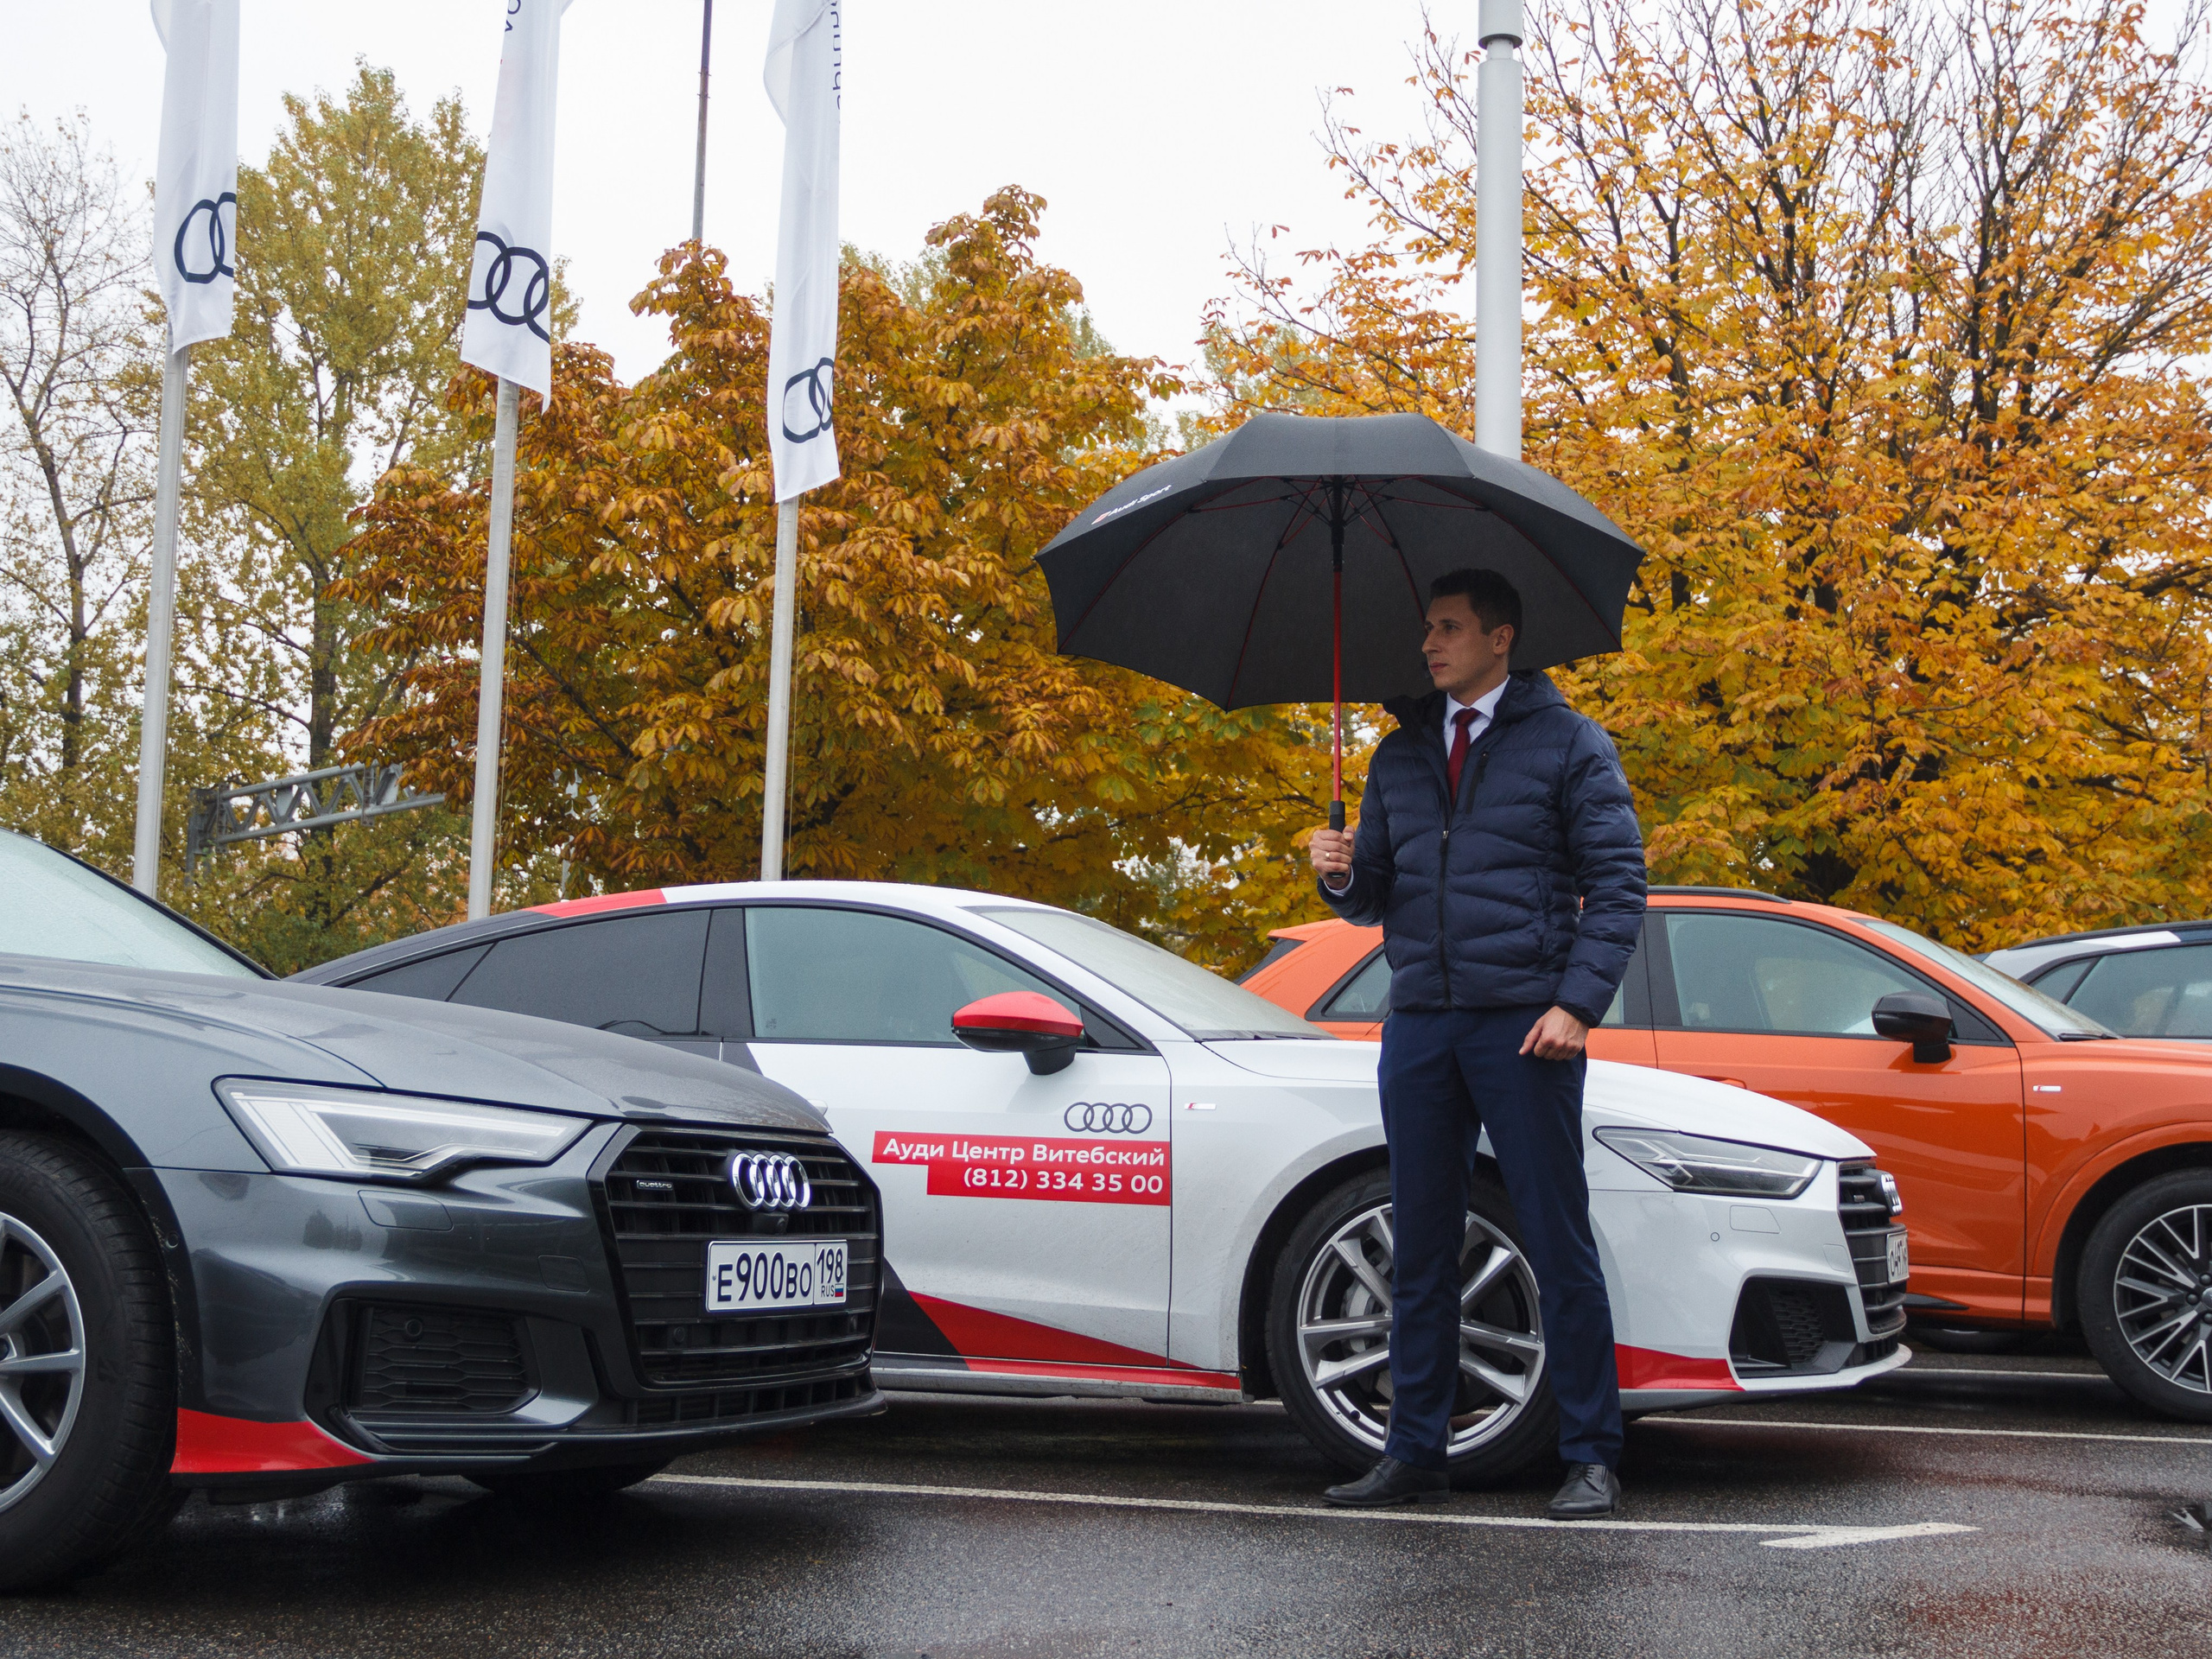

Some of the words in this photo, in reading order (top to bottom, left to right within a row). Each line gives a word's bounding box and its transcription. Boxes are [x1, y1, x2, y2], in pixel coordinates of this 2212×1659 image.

[1108, 499, 1138, 516] Audi
[1137, 485, 1172, 503] Sport
[883, 1138, 944, 1160] Ауди
[952, 1141, 1025, 1165] Центр
[1032, 1144, 1165, 1166] Витебский
[963, 1167, 1028, 1190] (812)
[1036, 1171, 1084, 1191] 334
[1091, 1173, 1122, 1192] 35
[1130, 1174, 1163, 1194] 00
[817, 1248, 843, 1283] 198
[821, 1285, 835, 1298] RUS
